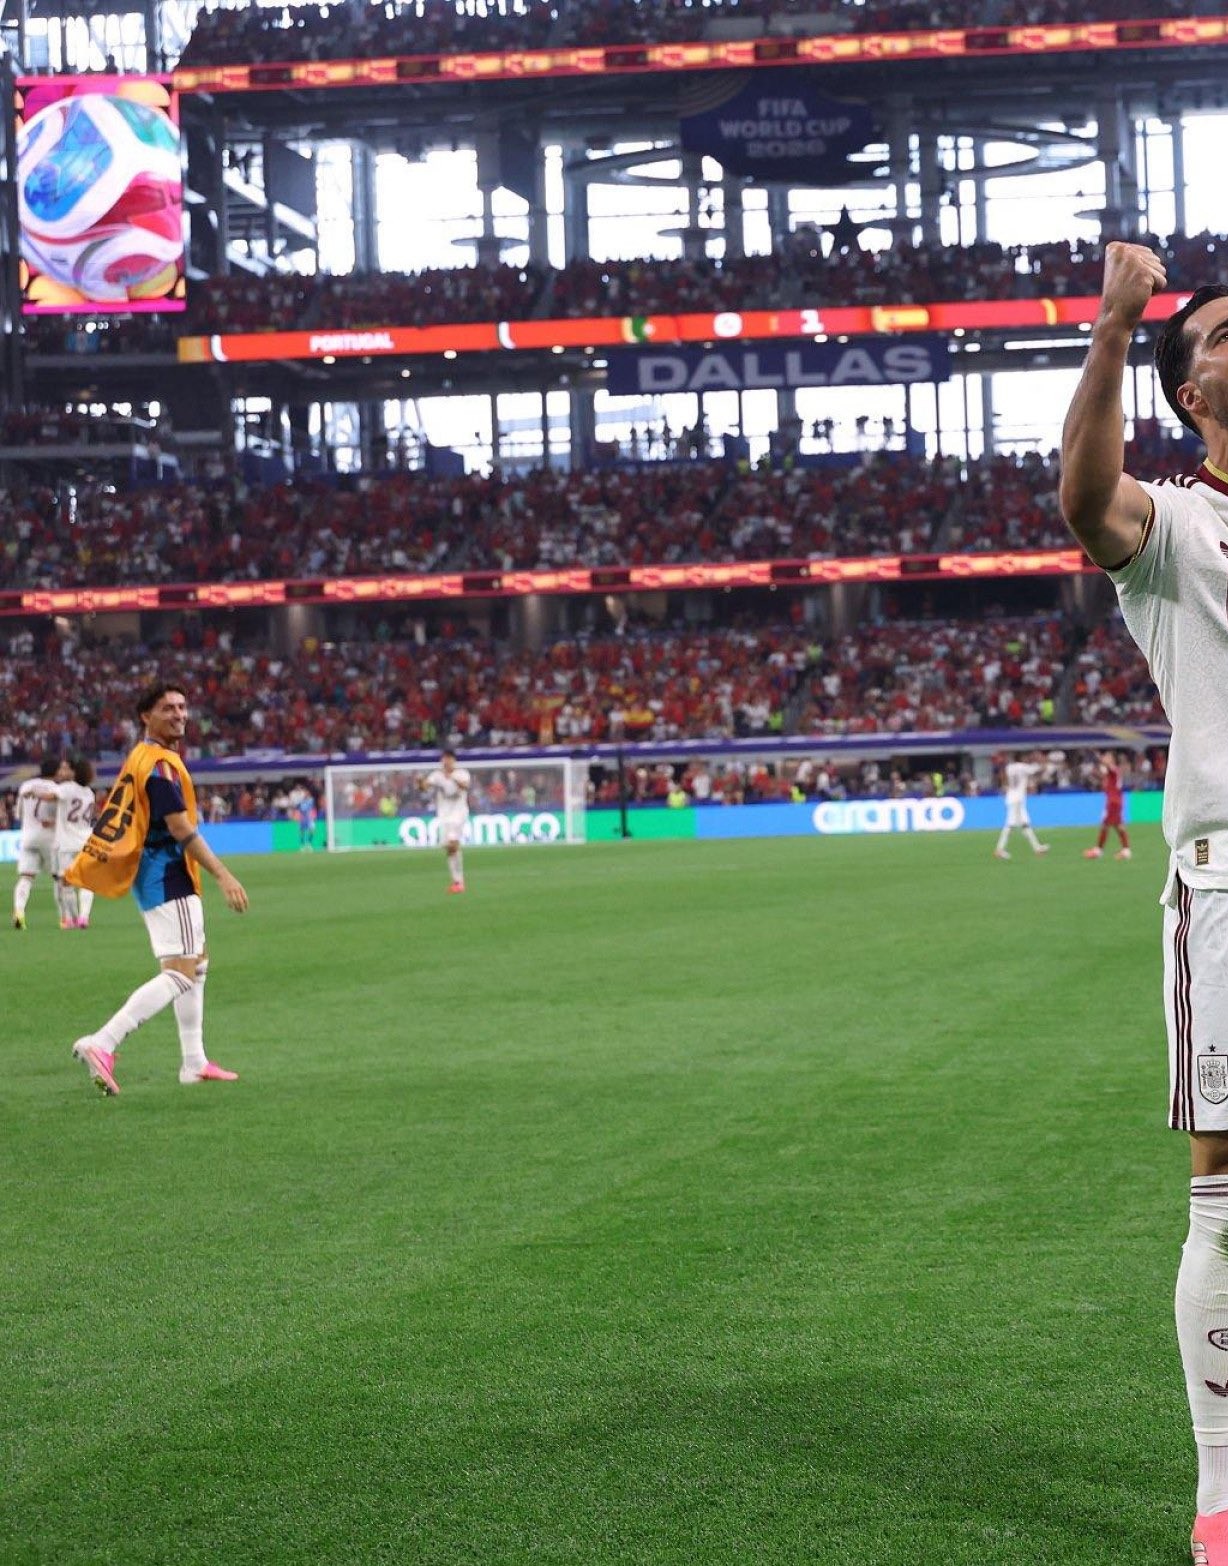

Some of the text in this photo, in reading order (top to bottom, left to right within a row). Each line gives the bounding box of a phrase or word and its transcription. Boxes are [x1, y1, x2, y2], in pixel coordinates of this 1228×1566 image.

[757, 99, 807, 117] FIFA
[720, 117, 851, 138] WORLD CUP
[309, 332, 395, 352] PORTUGAL
[801, 309, 825, 334] 1
[637, 346, 932, 391] DALLAS
[400, 812, 560, 847] armco
